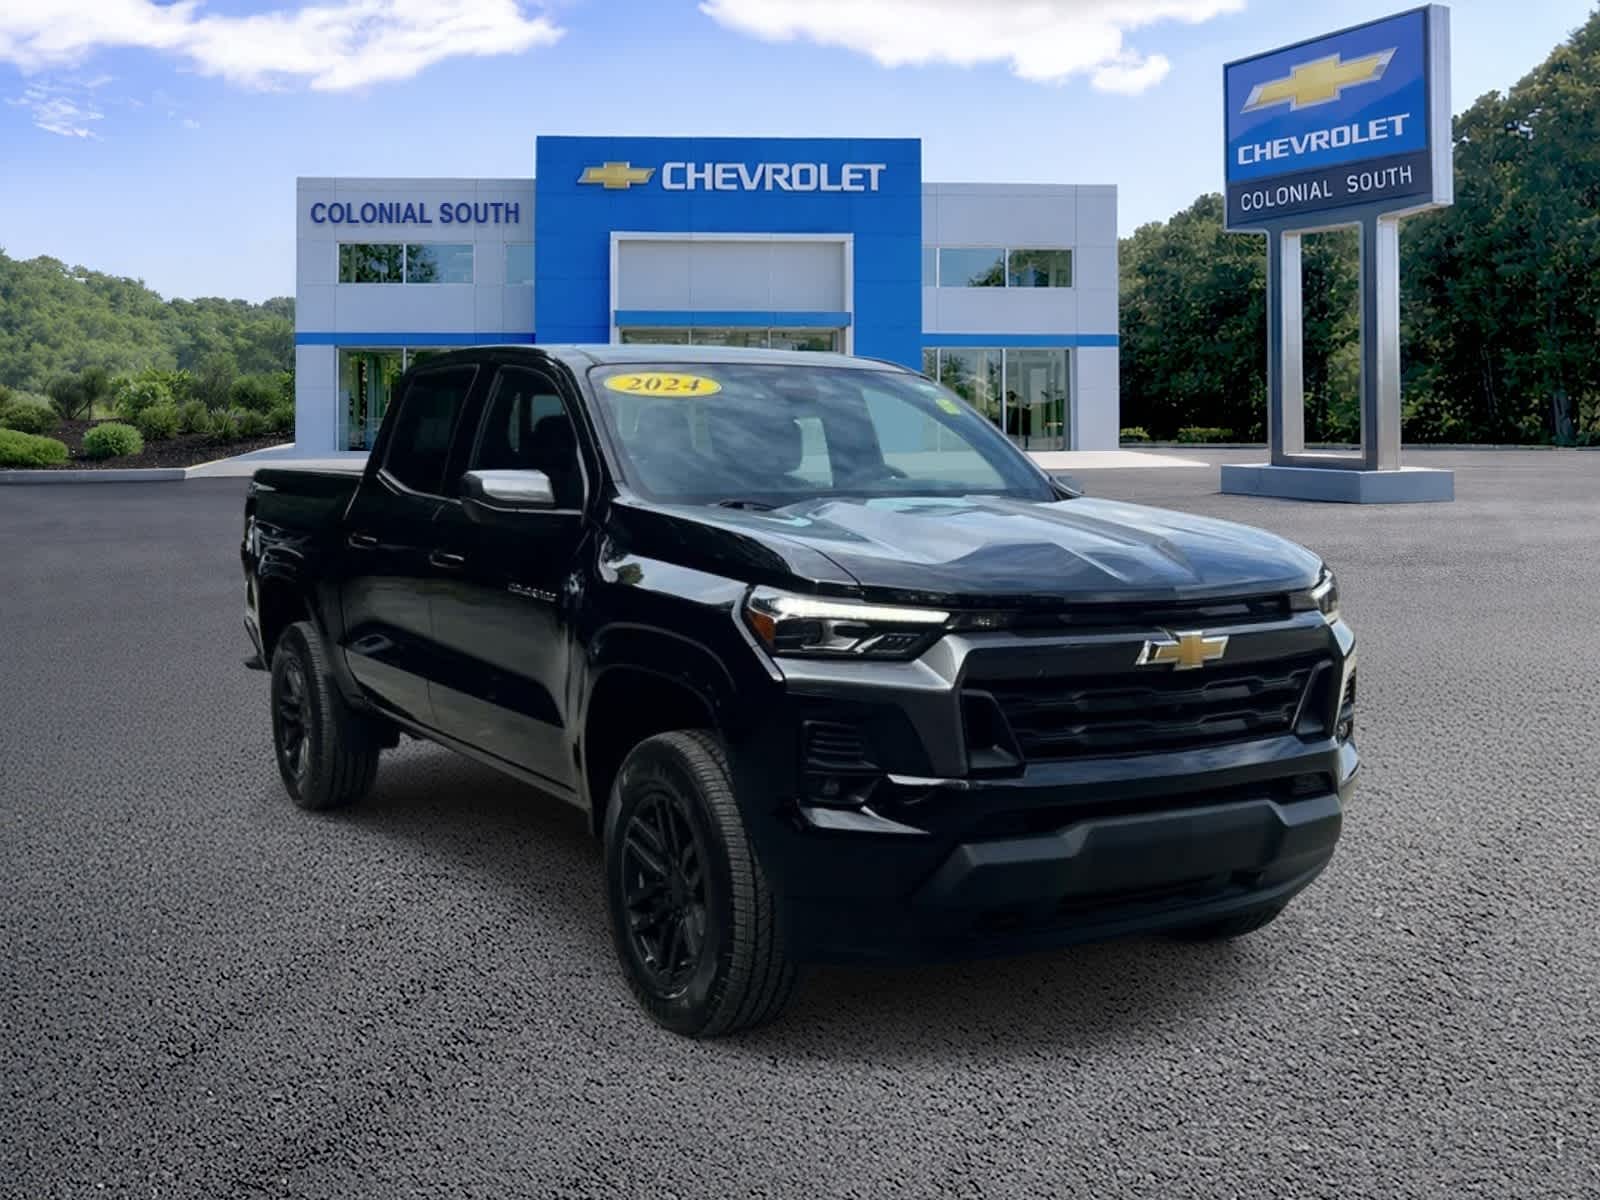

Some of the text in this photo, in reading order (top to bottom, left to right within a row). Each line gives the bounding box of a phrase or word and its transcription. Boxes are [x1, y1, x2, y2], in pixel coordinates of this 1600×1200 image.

[1237, 113, 1410, 165] CHEVROLET
[661, 162, 887, 192] CHEVROLET
[1240, 165, 1413, 212] COLONIAL SOUTH
[310, 202, 521, 225] COLONIAL SOUTH
[626, 377, 702, 392] 2024
